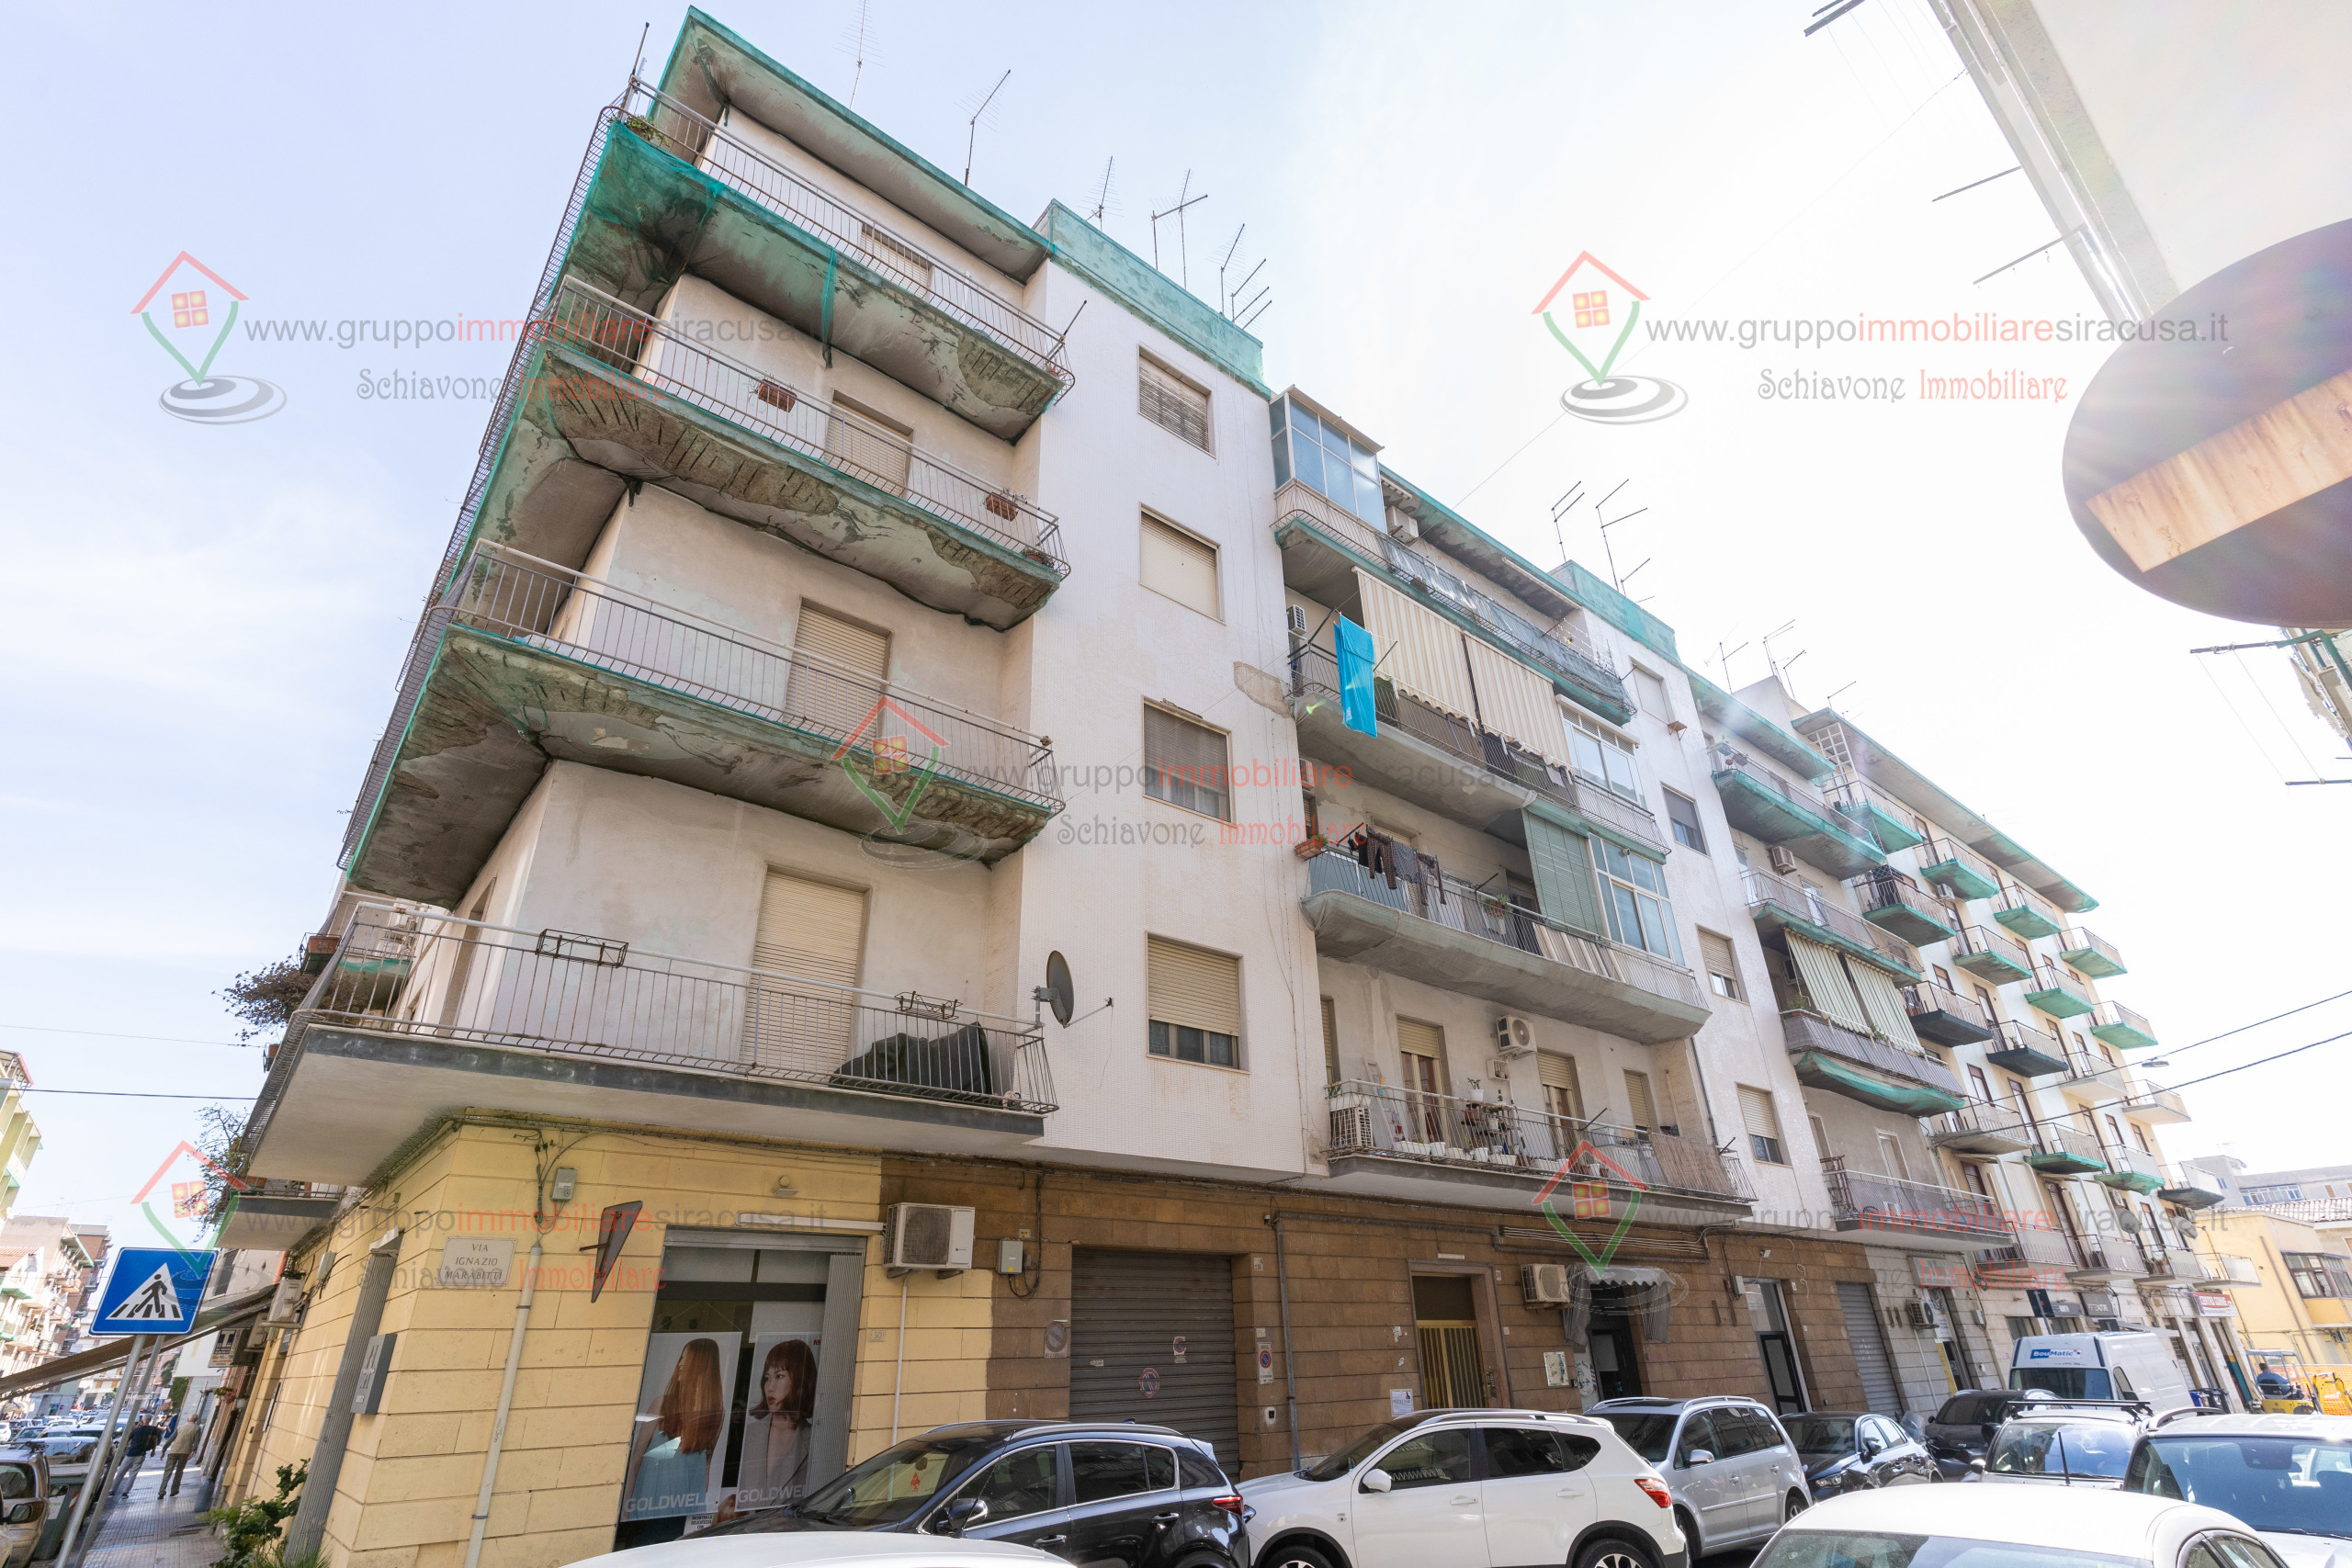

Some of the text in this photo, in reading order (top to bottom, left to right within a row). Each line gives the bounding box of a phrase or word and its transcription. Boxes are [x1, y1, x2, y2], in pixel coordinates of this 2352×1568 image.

[472, 1244, 488, 1252] VIA
[456, 1257, 498, 1266] IGNAZIO
[445, 1270, 503, 1280] MARABITTI
